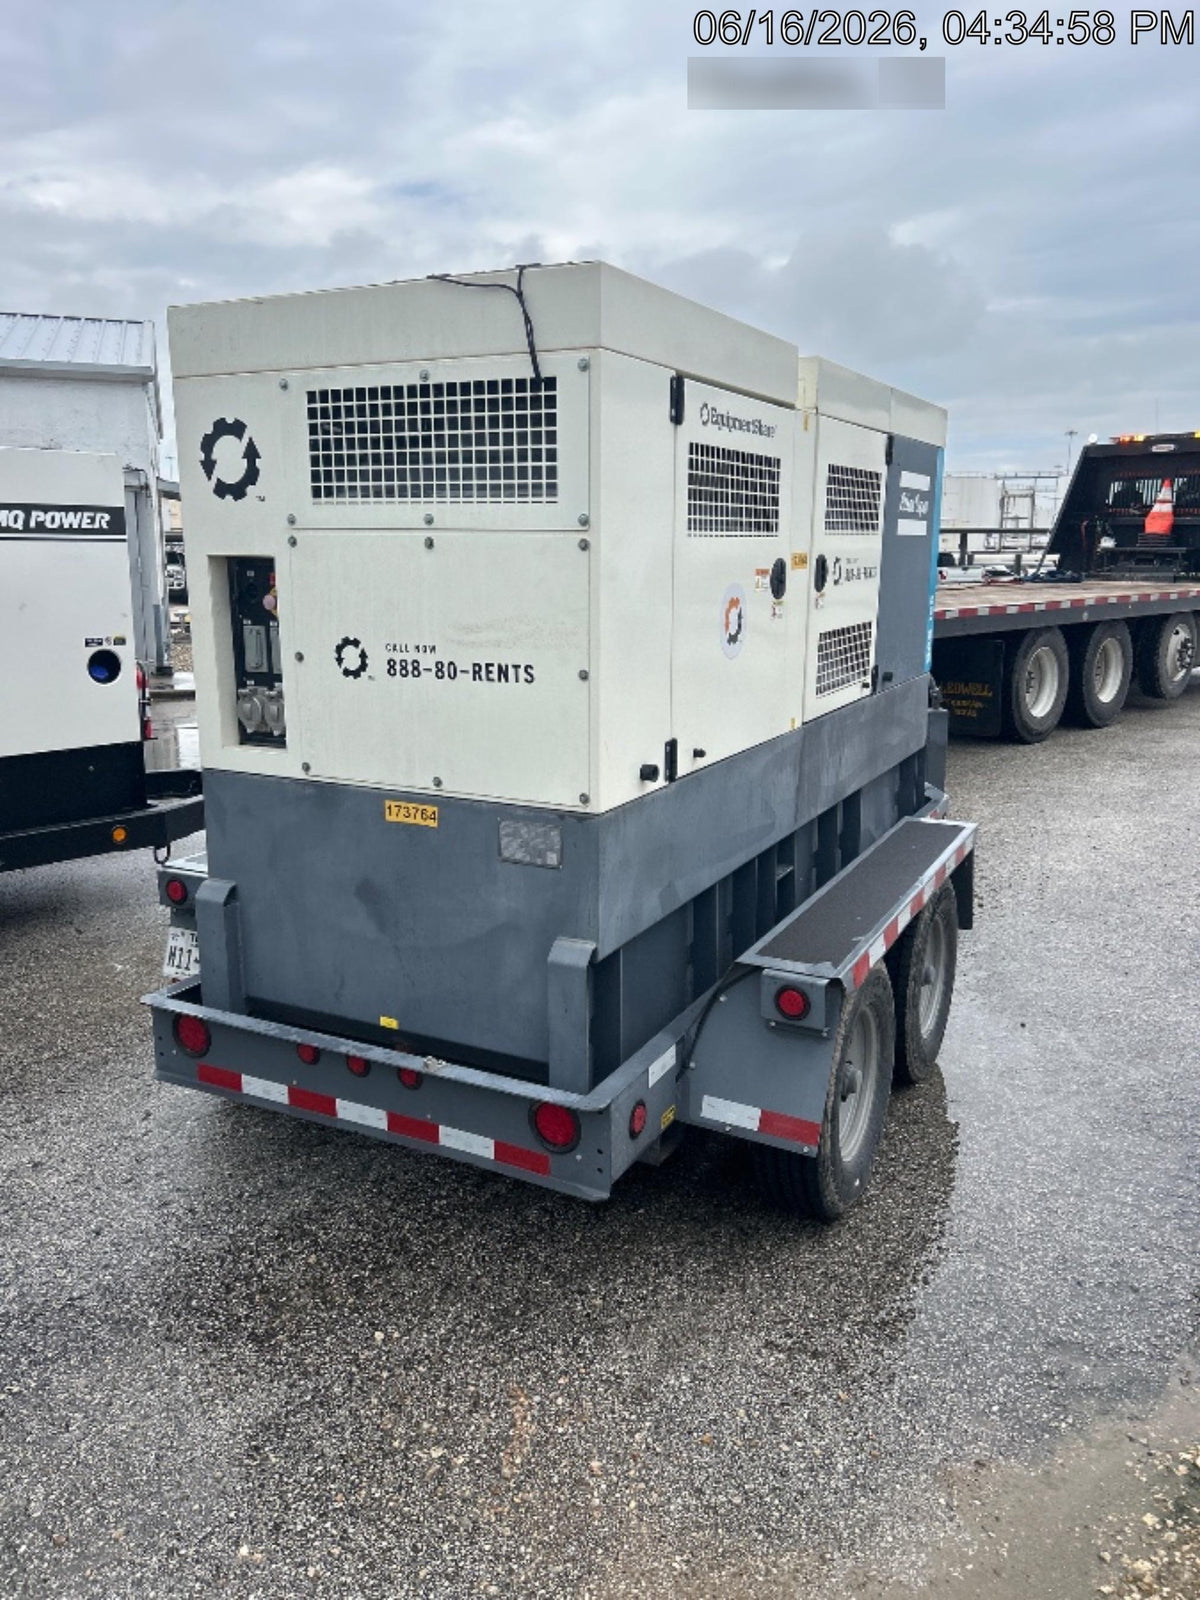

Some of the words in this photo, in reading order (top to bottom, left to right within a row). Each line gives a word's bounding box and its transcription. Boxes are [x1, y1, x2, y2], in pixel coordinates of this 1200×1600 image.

[29, 510, 111, 530] POWER
[385, 643, 411, 654] CALL
[414, 644, 437, 655] NOW
[386, 658, 535, 684] 888-80-RENTS
[386, 803, 438, 824] 173764
